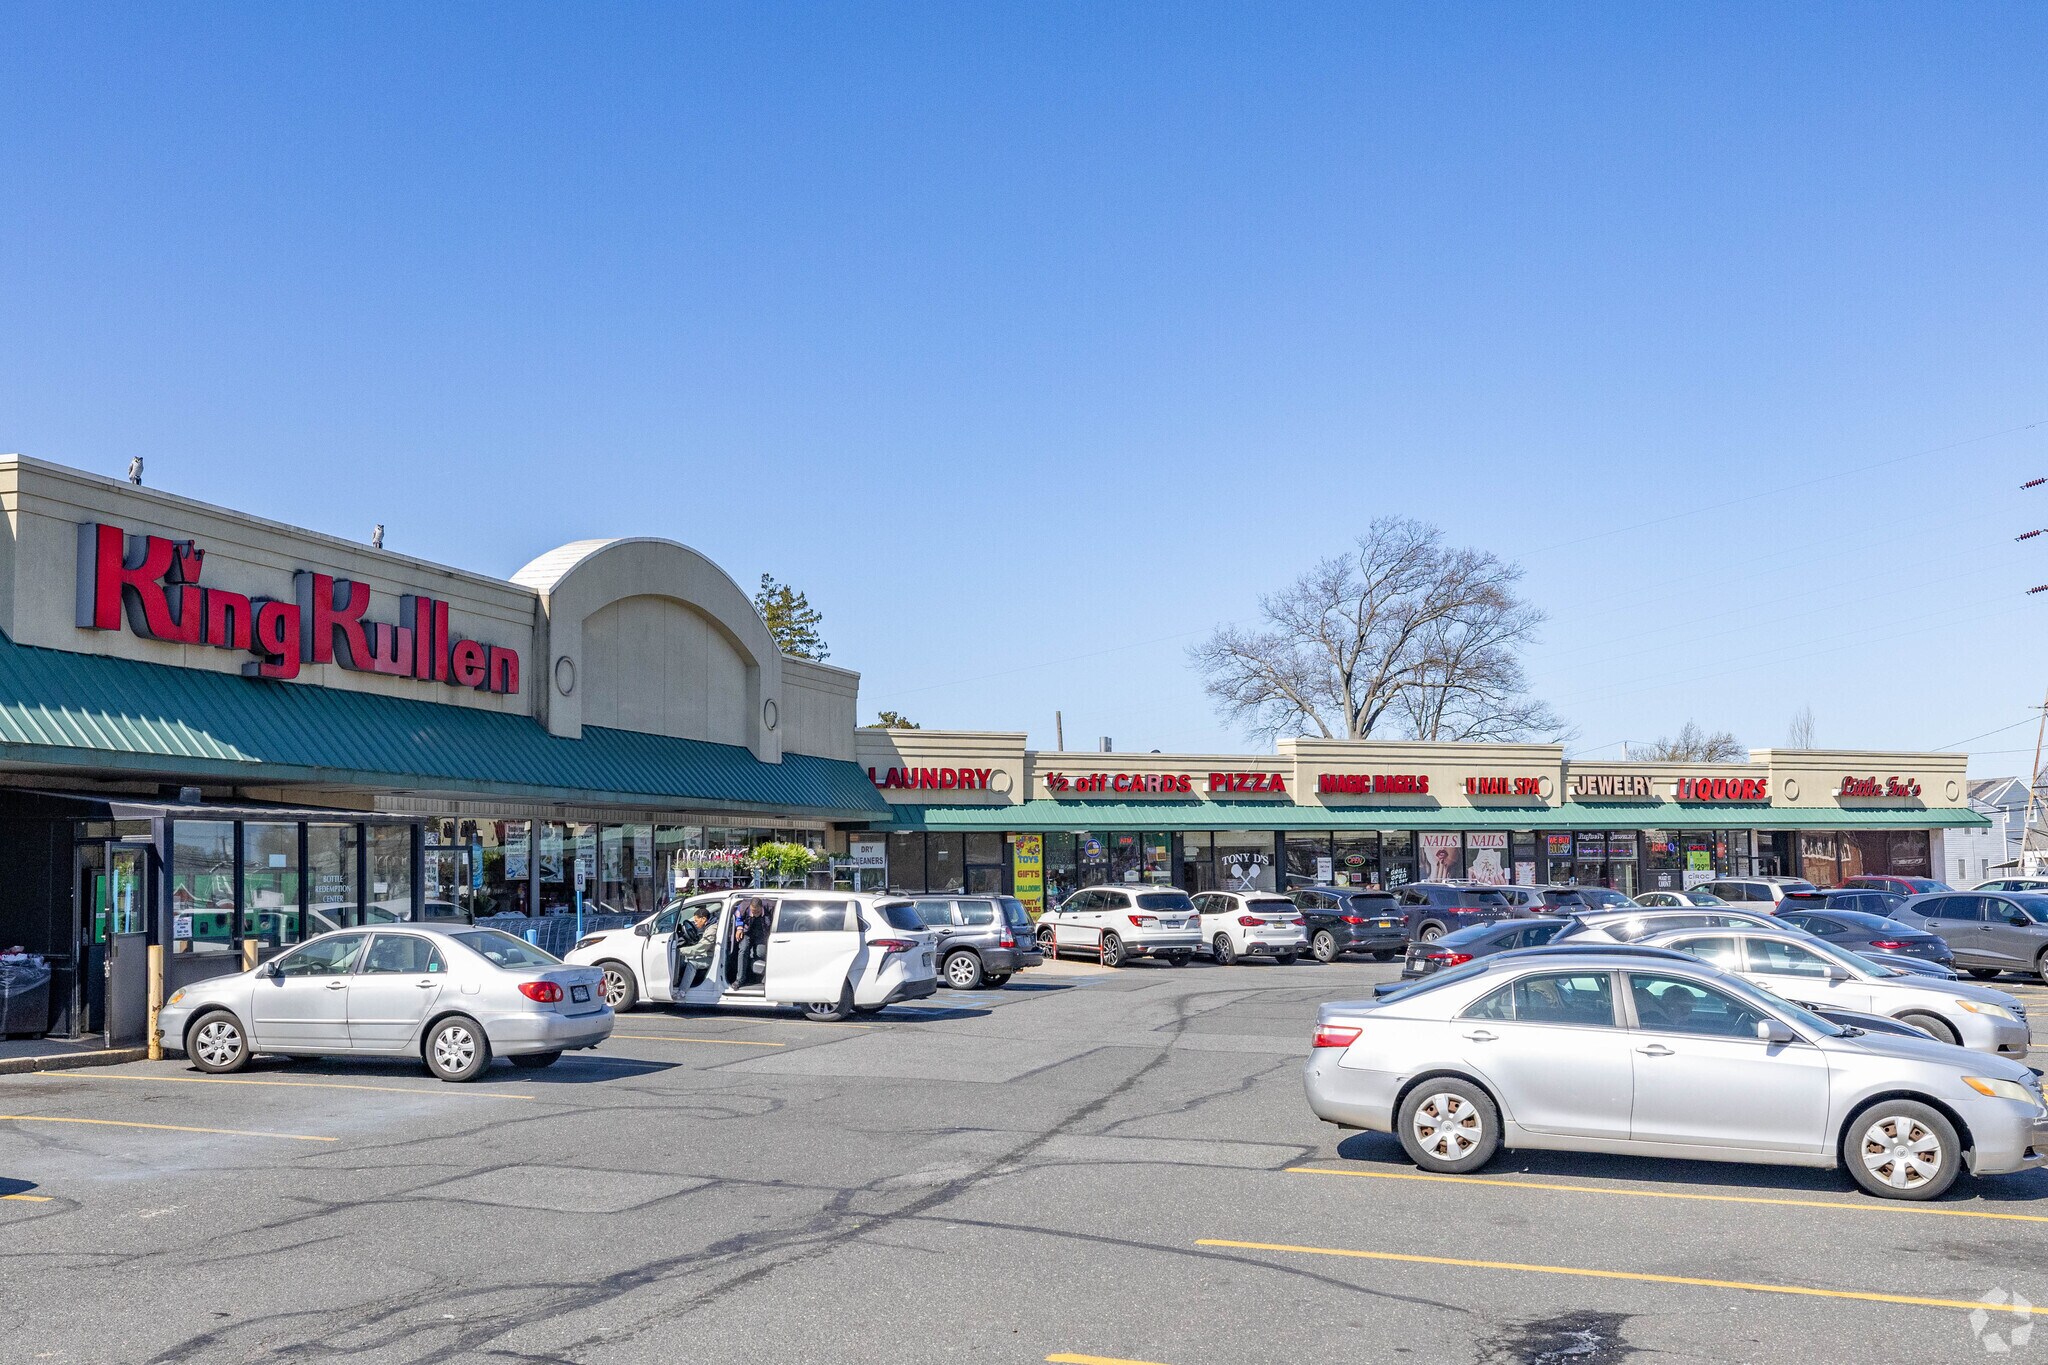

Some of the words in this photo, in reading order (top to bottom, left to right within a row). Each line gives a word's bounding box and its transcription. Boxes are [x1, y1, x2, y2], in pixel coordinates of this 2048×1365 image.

[77, 522, 301, 680] King
[298, 571, 520, 695] Kullen
[868, 767, 992, 790] LAUNDRY
[1075, 773, 1108, 792] off
[1112, 773, 1192, 793] CARDS
[1208, 772, 1287, 793] PIZZA
[1318, 774, 1370, 793] MAGIC
[1373, 774, 1429, 794] BAGELS
[1466, 777, 1477, 795] U
[1479, 777, 1511, 795] NAIL
[1514, 777, 1540, 795] SPA
[1576, 775, 1655, 796] JEWELRY
[1677, 777, 1767, 801] LIQUORS
[1839, 775, 1883, 797] Little
[1423, 835, 1458, 847] NAILS
[1471, 834, 1505, 847] NAILS
[1558, 836, 1570, 844] BUY
[860, 845, 874, 853] DRY
[851, 856, 884, 865] CLEANERS
[1018, 855, 1039, 864] TOYS
[1221, 853, 1250, 866] TONY
[322, 874, 344, 883] BOTTLE
[1017, 870, 1040, 878] GIFTS
[314, 884, 352, 893] REDEMPTION
[322, 895, 344, 903] CENTER
